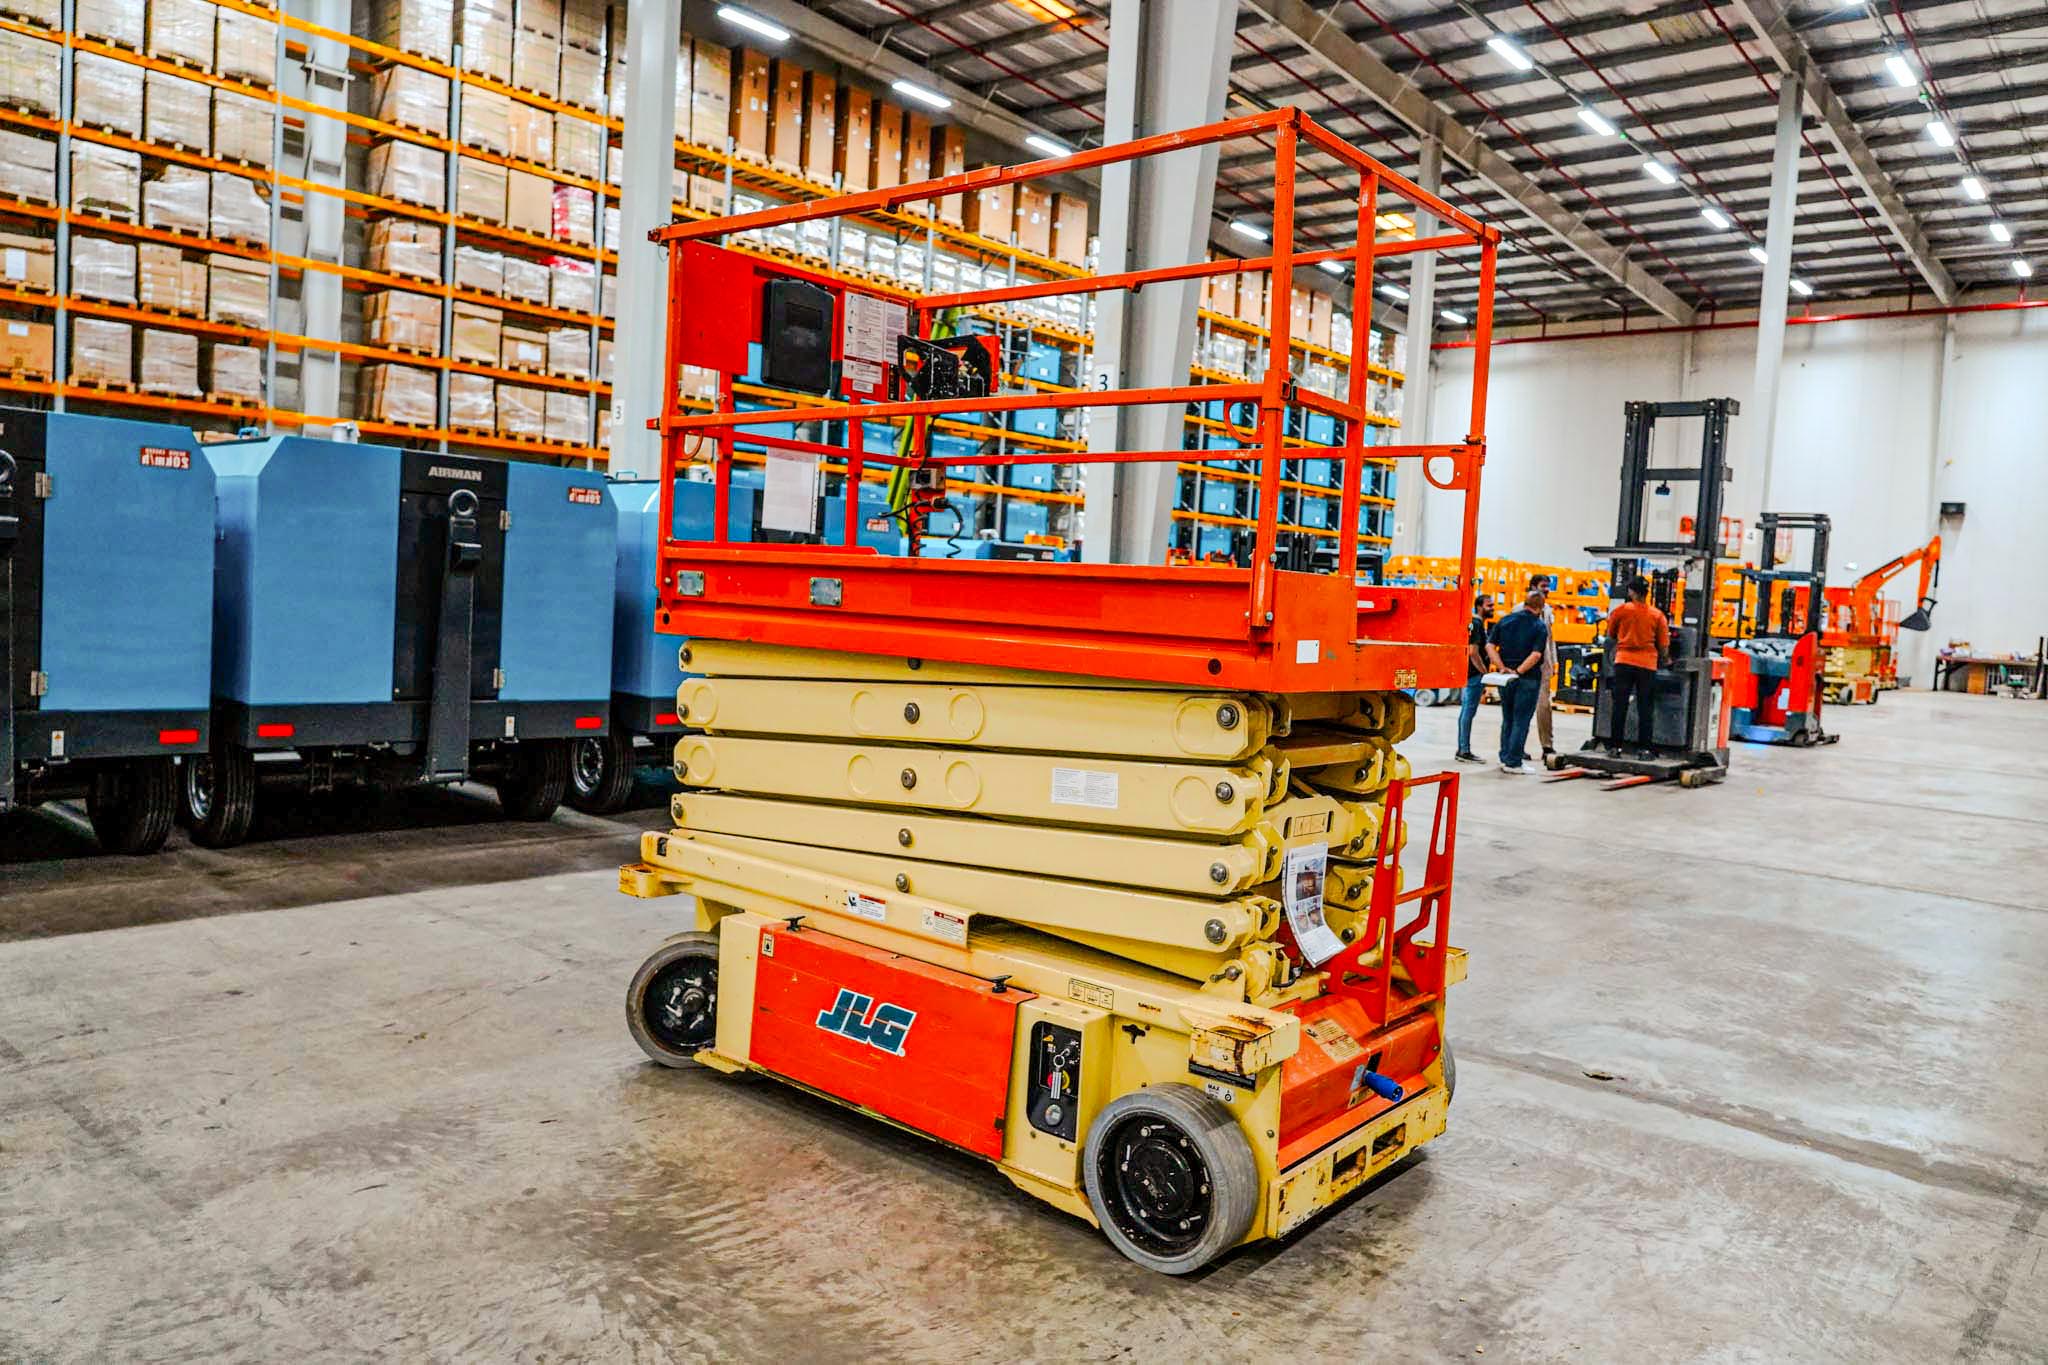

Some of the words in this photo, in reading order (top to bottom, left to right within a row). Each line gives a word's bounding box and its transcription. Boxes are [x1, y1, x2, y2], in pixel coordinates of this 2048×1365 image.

[1099, 374, 1108, 391] 3
[615, 405, 621, 420] 3
[428, 466, 482, 481] AIRMAN
[816, 987, 917, 1056] JLG
